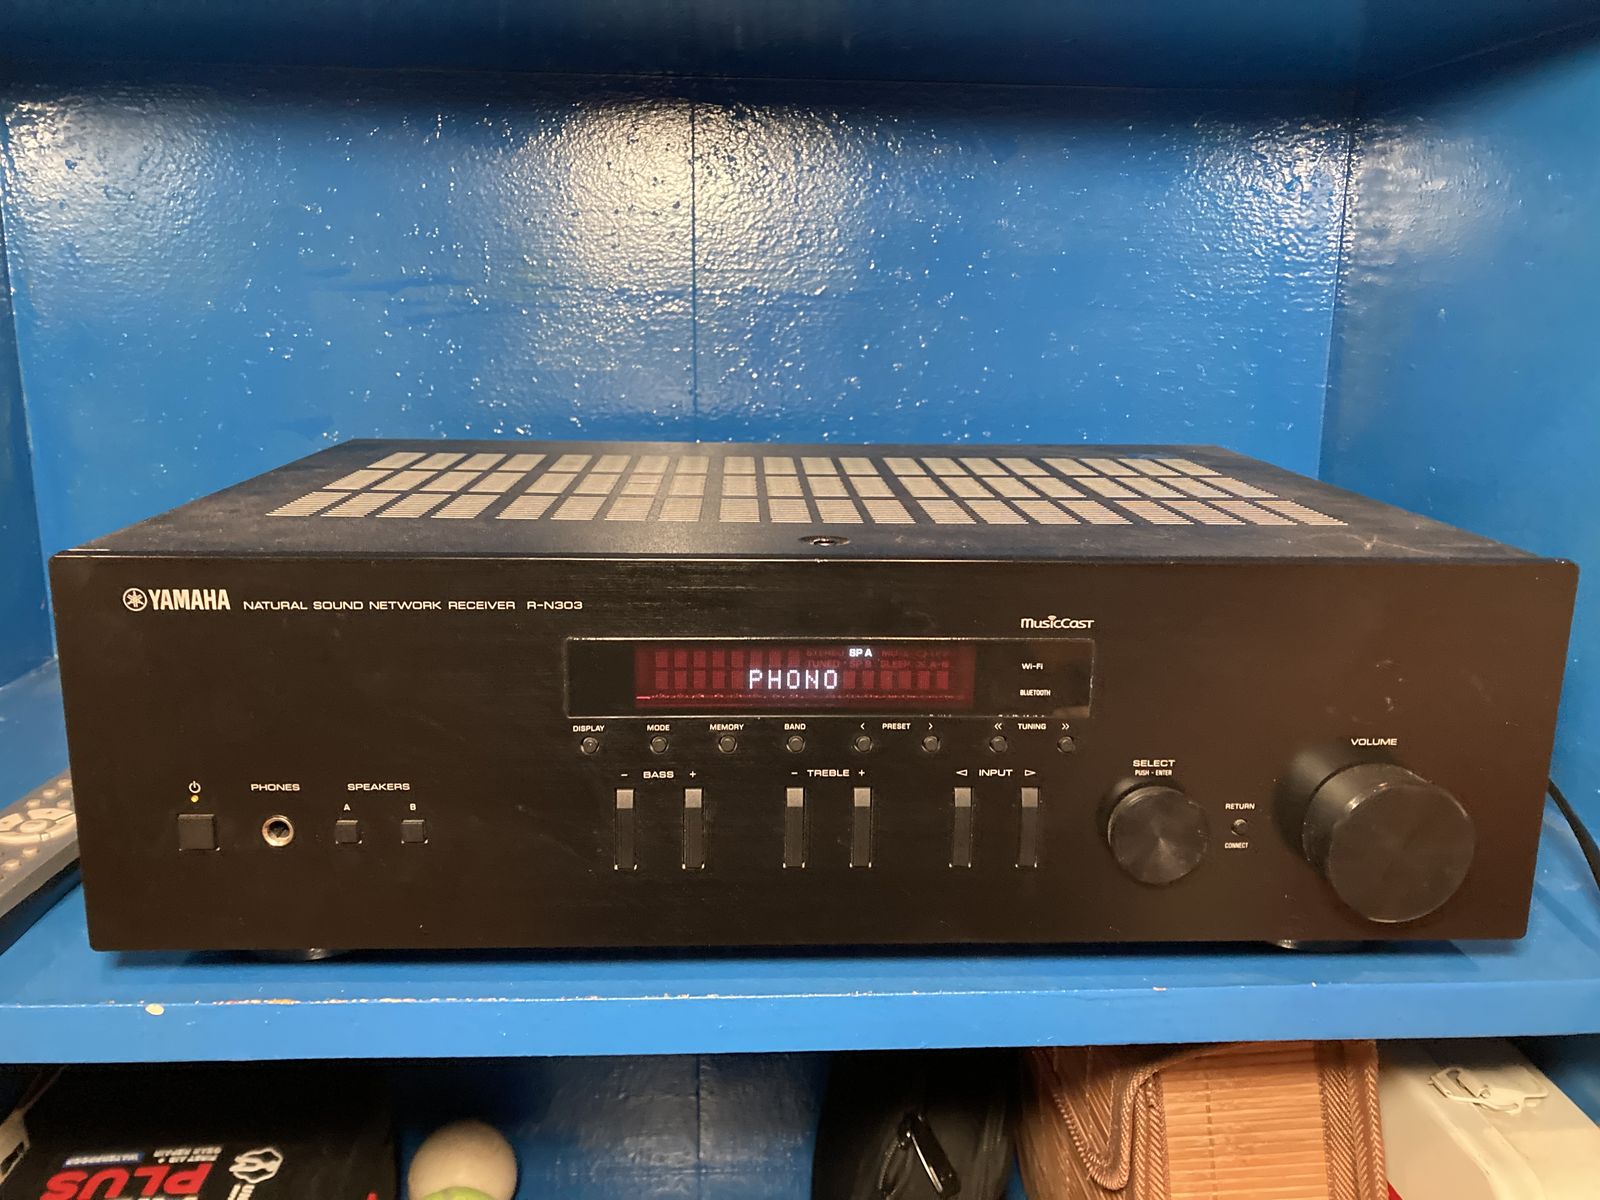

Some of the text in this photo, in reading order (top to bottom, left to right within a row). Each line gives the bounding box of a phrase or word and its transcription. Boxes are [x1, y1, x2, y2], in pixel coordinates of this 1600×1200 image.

[147, 588, 231, 611] YAMAHA
[243, 600, 583, 610] NATURAL SOUND NETWORK RECEIVER R-N303
[1020, 615, 1095, 629] MusicCast
[1021, 662, 1044, 670] Wi-Fi
[748, 669, 838, 690] PHONO
[1019, 689, 1051, 697] BLUETOOTH
[572, 724, 605, 733] DISPLAY
[646, 724, 671, 732] MODE
[709, 723, 745, 731] MEMORY
[784, 723, 807, 731] BAND
[881, 722, 911, 730] PRESET
[1017, 722, 1047, 730] TUNING
[1350, 738, 1398, 746] VOLUME
[1132, 759, 1176, 768] SELECT
[643, 770, 675, 779] BASS
[806, 769, 850, 777] TREBLE
[978, 768, 1014, 777] INPUT
[250, 783, 301, 792] PHONES
[347, 782, 411, 791] SPEAKERS
[1225, 802, 1256, 810] RETURN
[1224, 841, 1249, 849] CONNECT
[39, 1162, 213, 1200] PLUS
